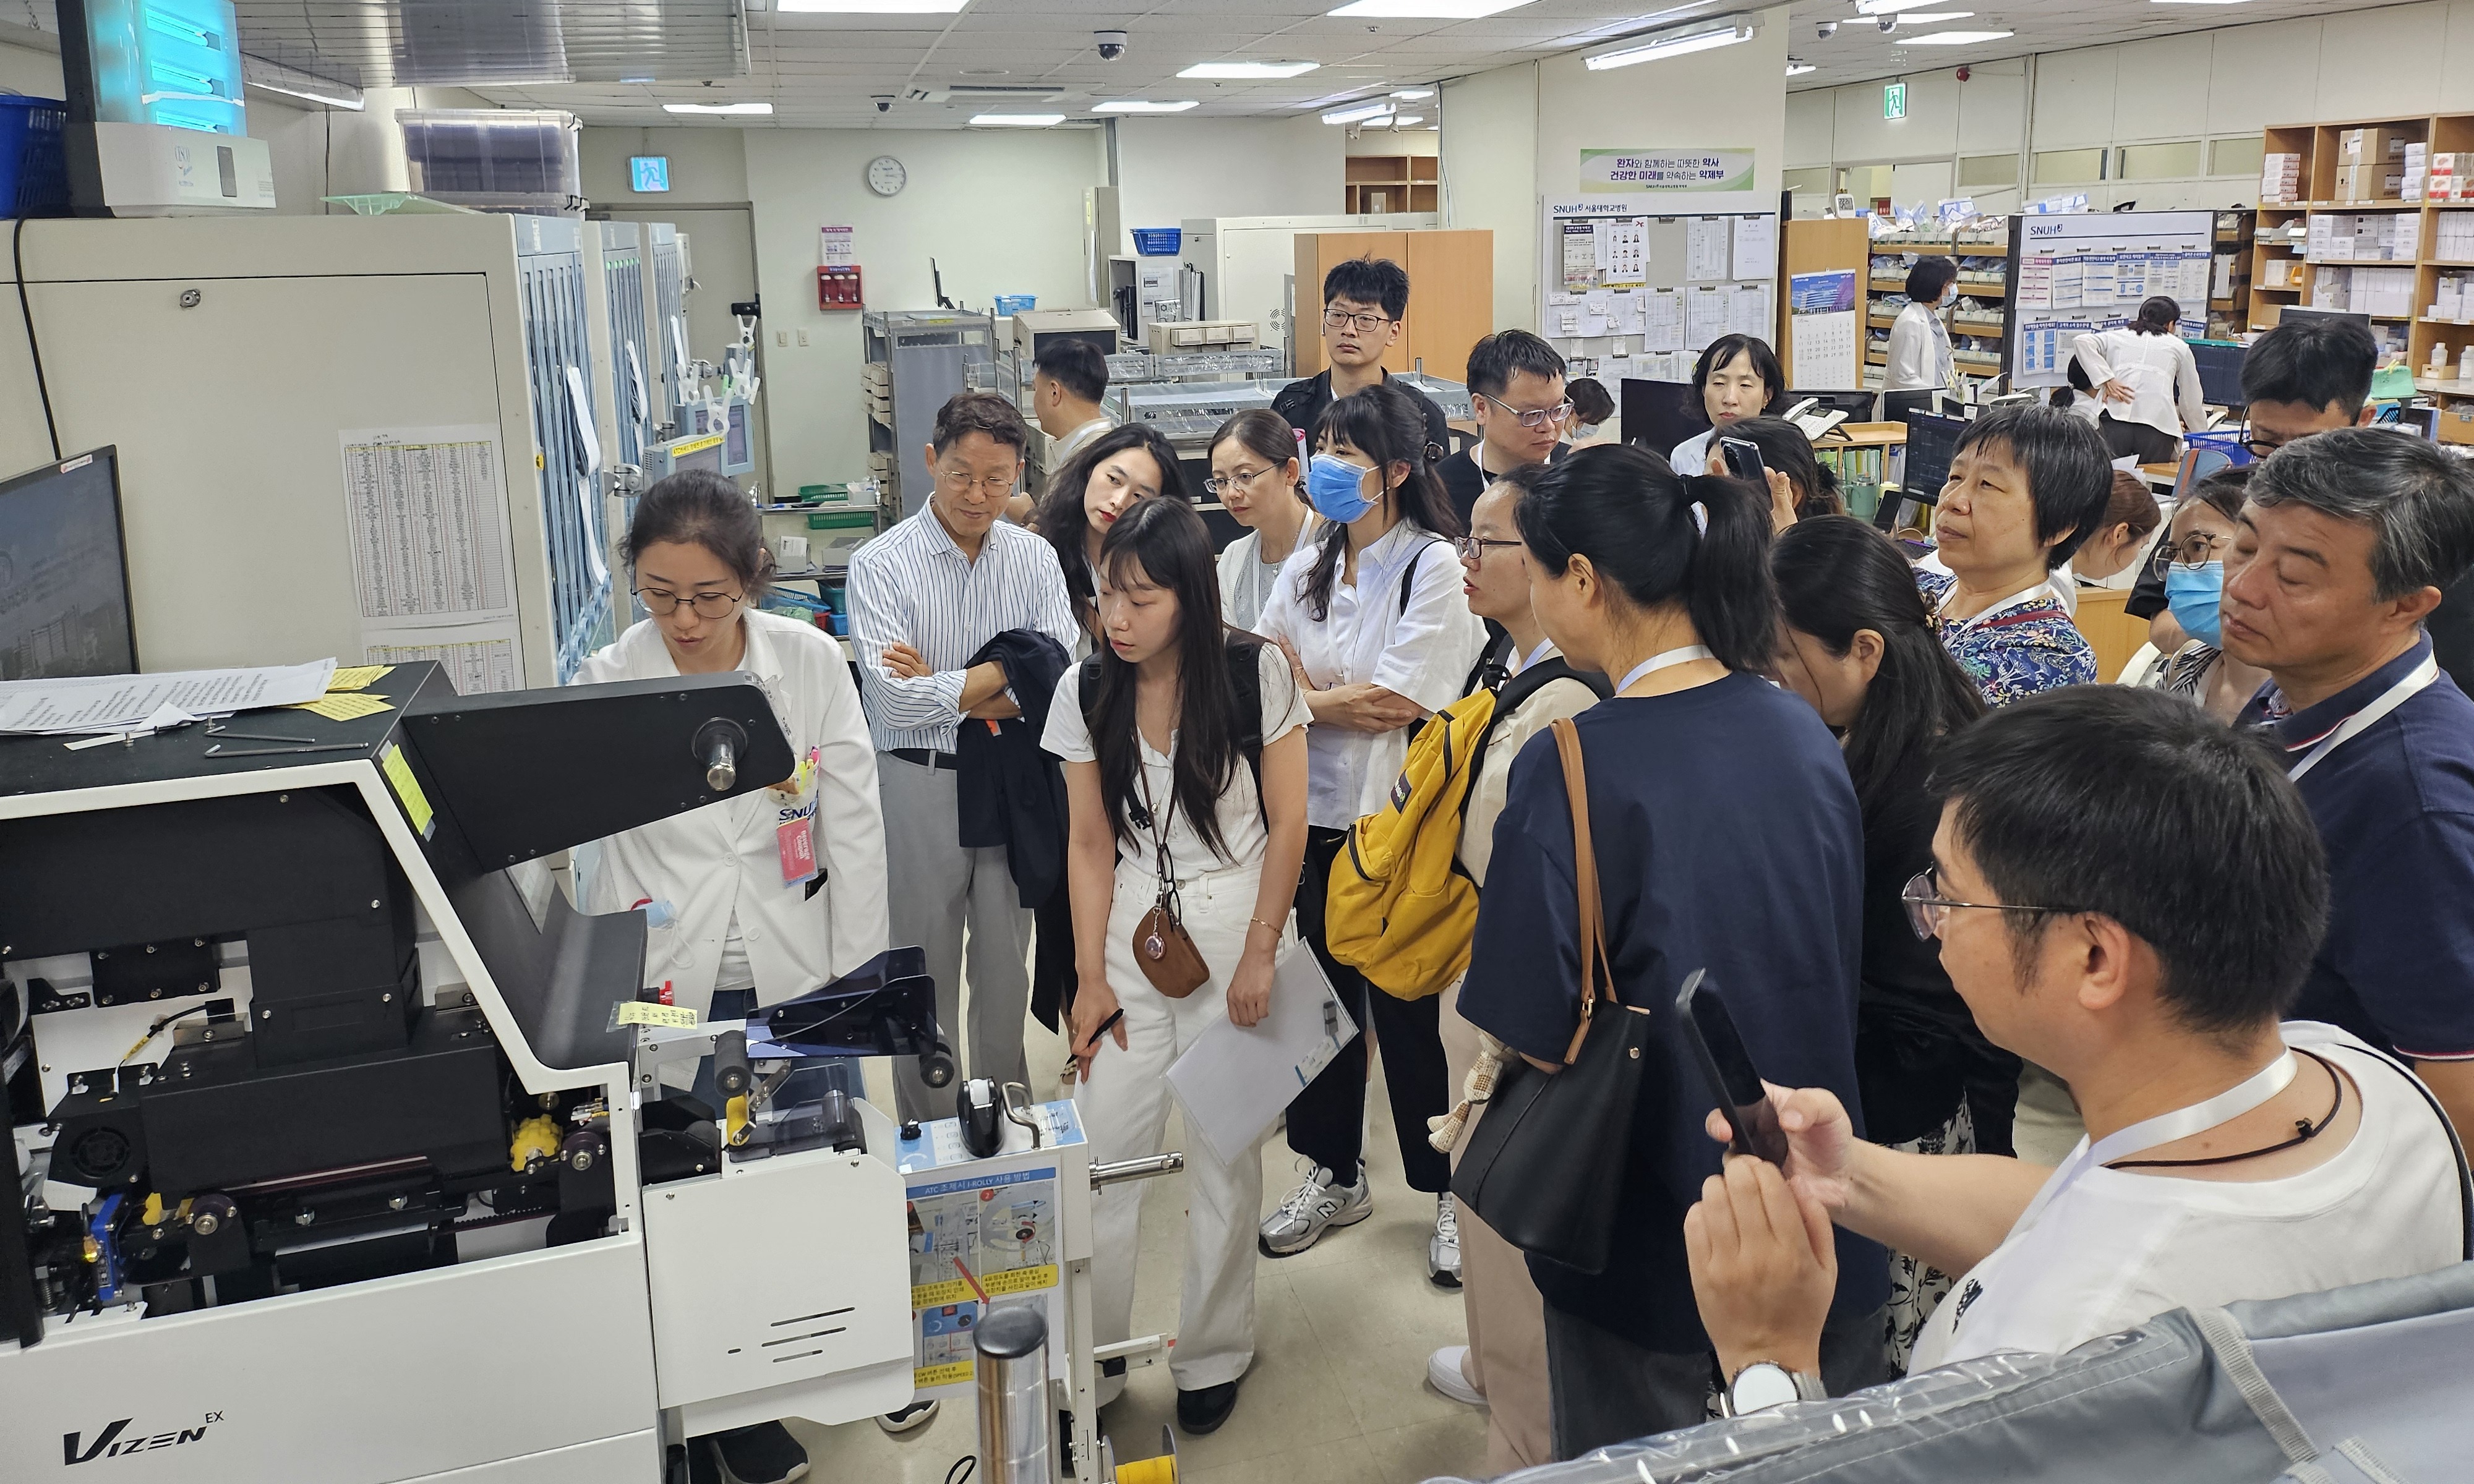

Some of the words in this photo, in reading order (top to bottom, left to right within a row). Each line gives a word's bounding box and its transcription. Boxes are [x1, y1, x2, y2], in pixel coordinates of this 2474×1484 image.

[1617, 158, 1642, 168] 환자와
[1645, 159, 1675, 168] 함께하는
[1677, 159, 1700, 168] 따뜻한
[1703, 157, 1719, 168] 약사
[1610, 171, 1637, 181] 건강한
[1639, 170, 1664, 181] 미래를
[1666, 171, 1696, 181] 약속하는
[1699, 169, 1724, 180] 약제부
[1553, 205, 1577, 213] SNUH
[1585, 204, 1627, 212] 서울대학교병원
[2030, 225, 2057, 236] SNUH
[941, 1180, 965, 1192] 조제시
[967, 1179, 993, 1188] I-ROLLY
[996, 1174, 1011, 1184] 사용
[1013, 1171, 1030, 1181] 방법
[205, 1410, 225, 1423] EX
